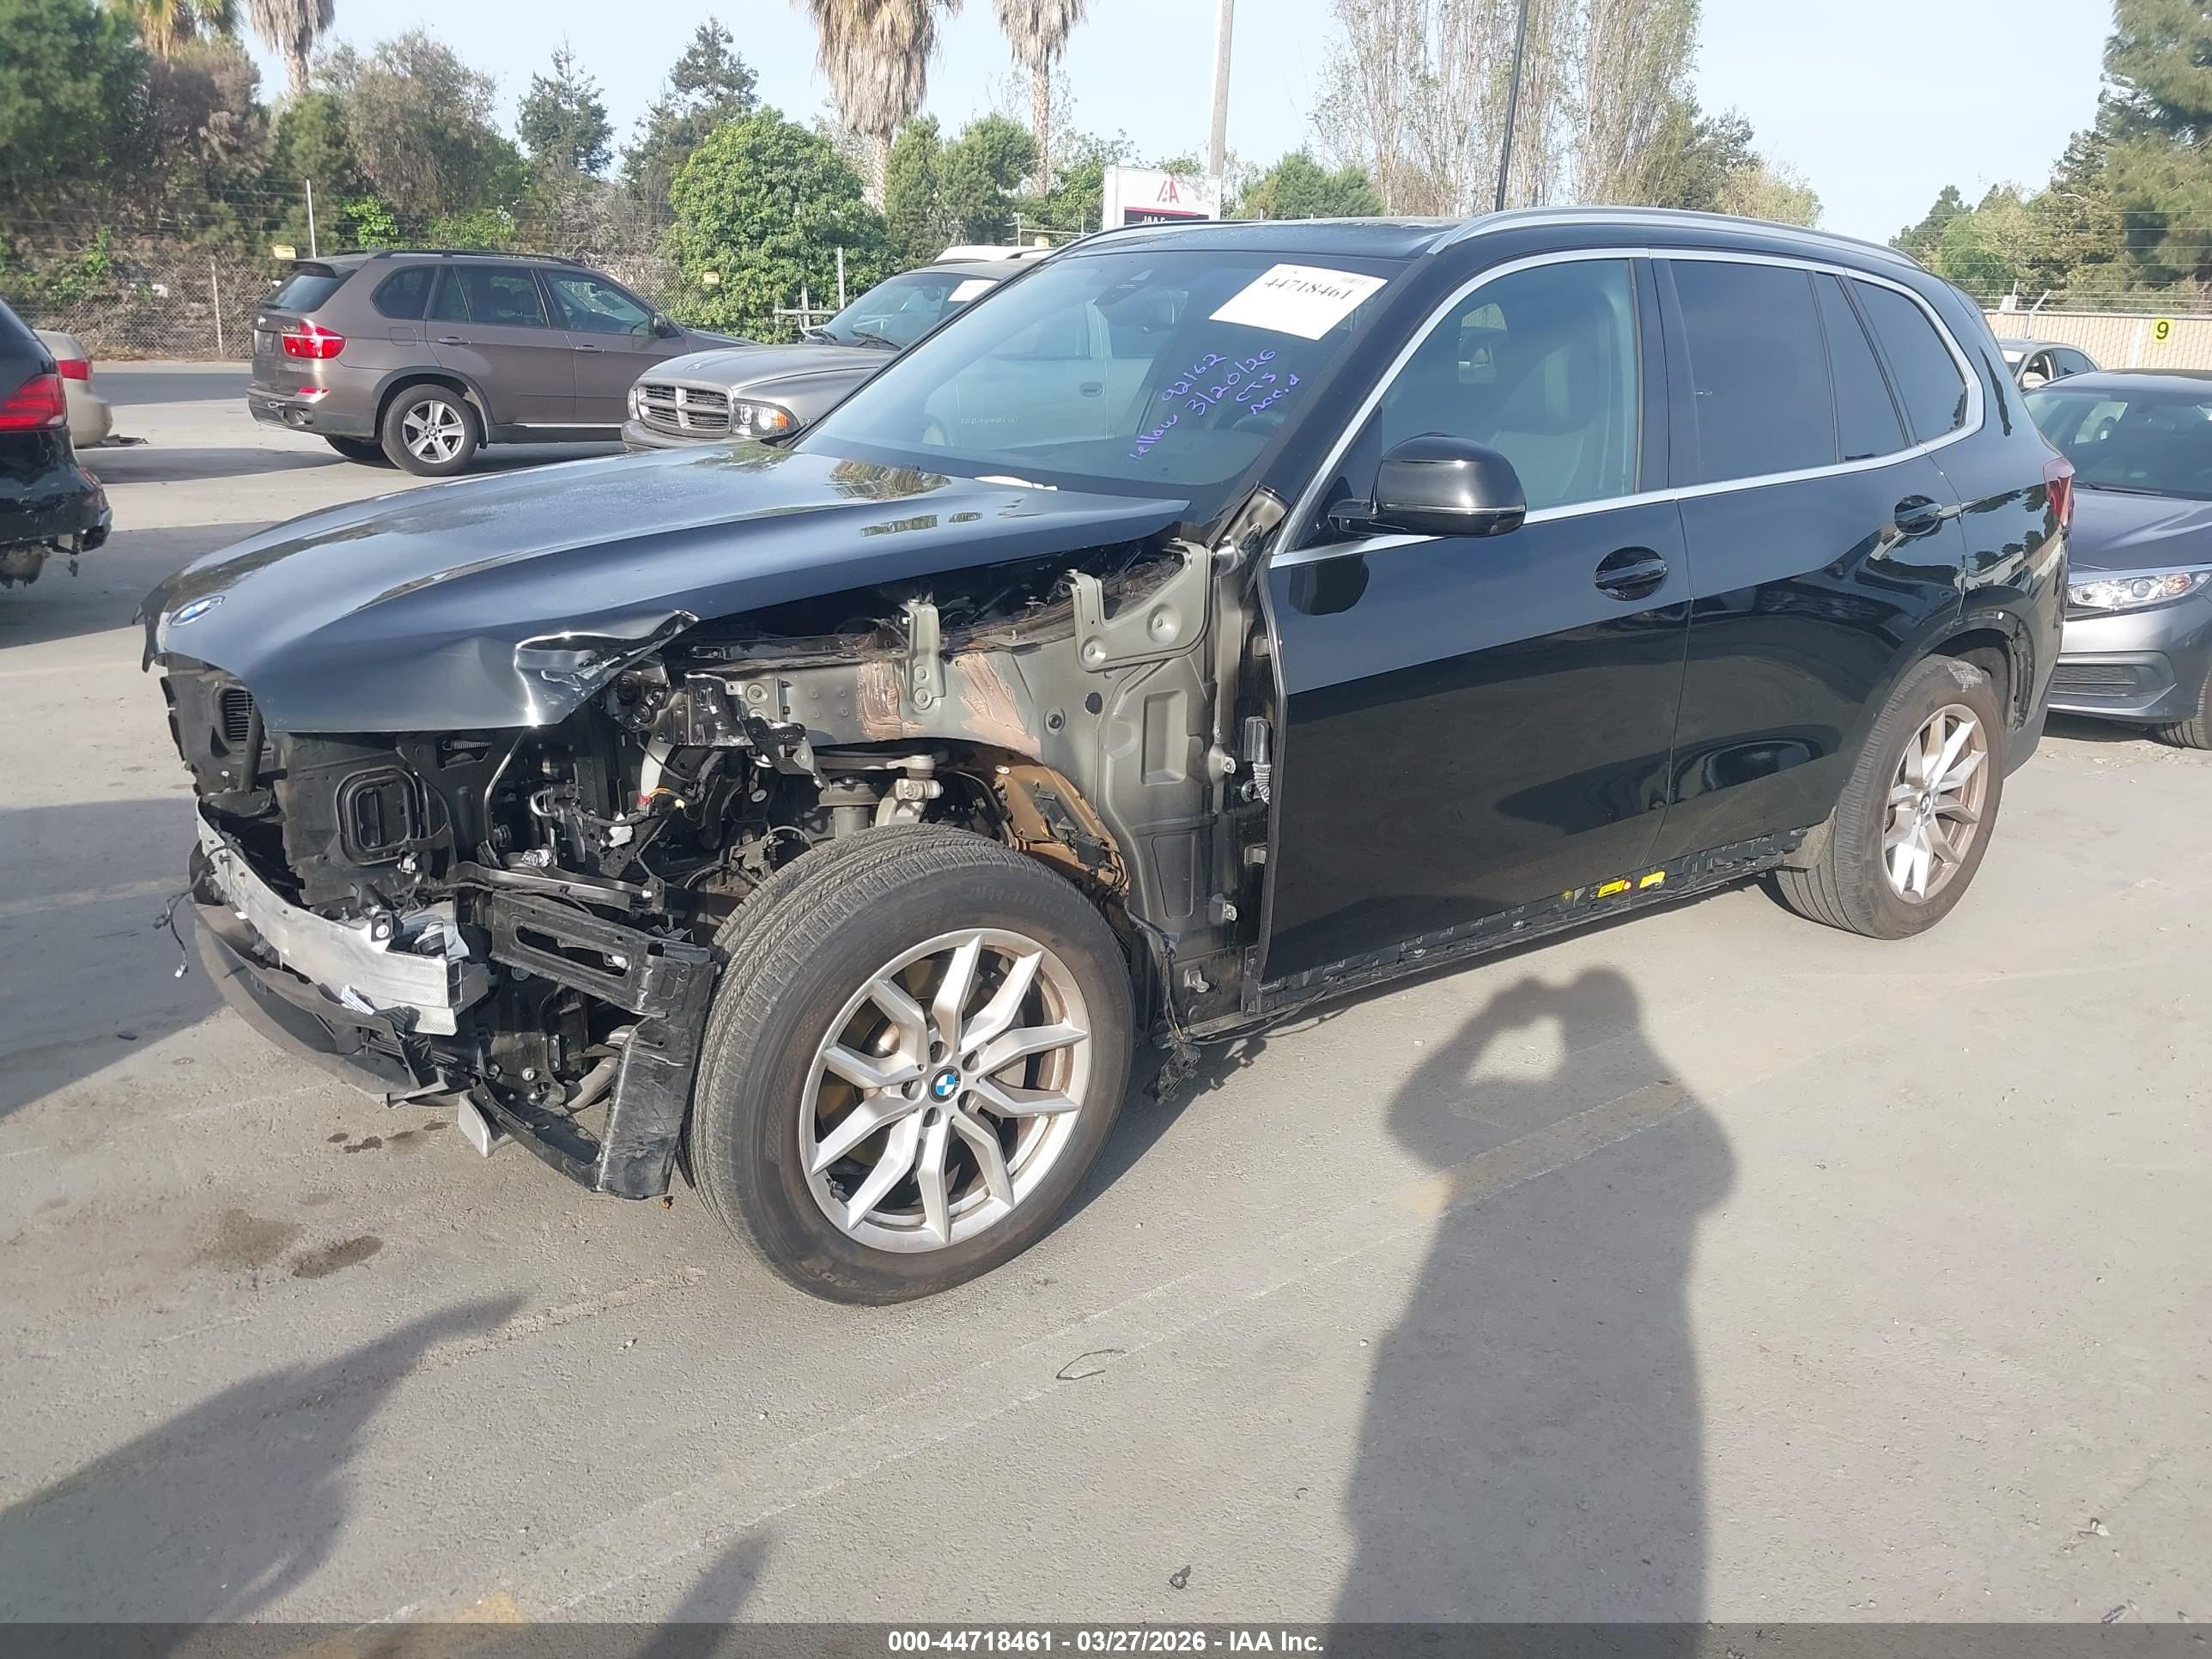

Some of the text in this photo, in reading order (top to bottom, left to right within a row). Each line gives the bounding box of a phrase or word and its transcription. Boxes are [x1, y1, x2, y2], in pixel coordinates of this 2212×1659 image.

[1265, 278, 1353, 300] 44718461
[2155, 321, 2170, 340] 9
[1184, 349, 1276, 416] 3/20/26
